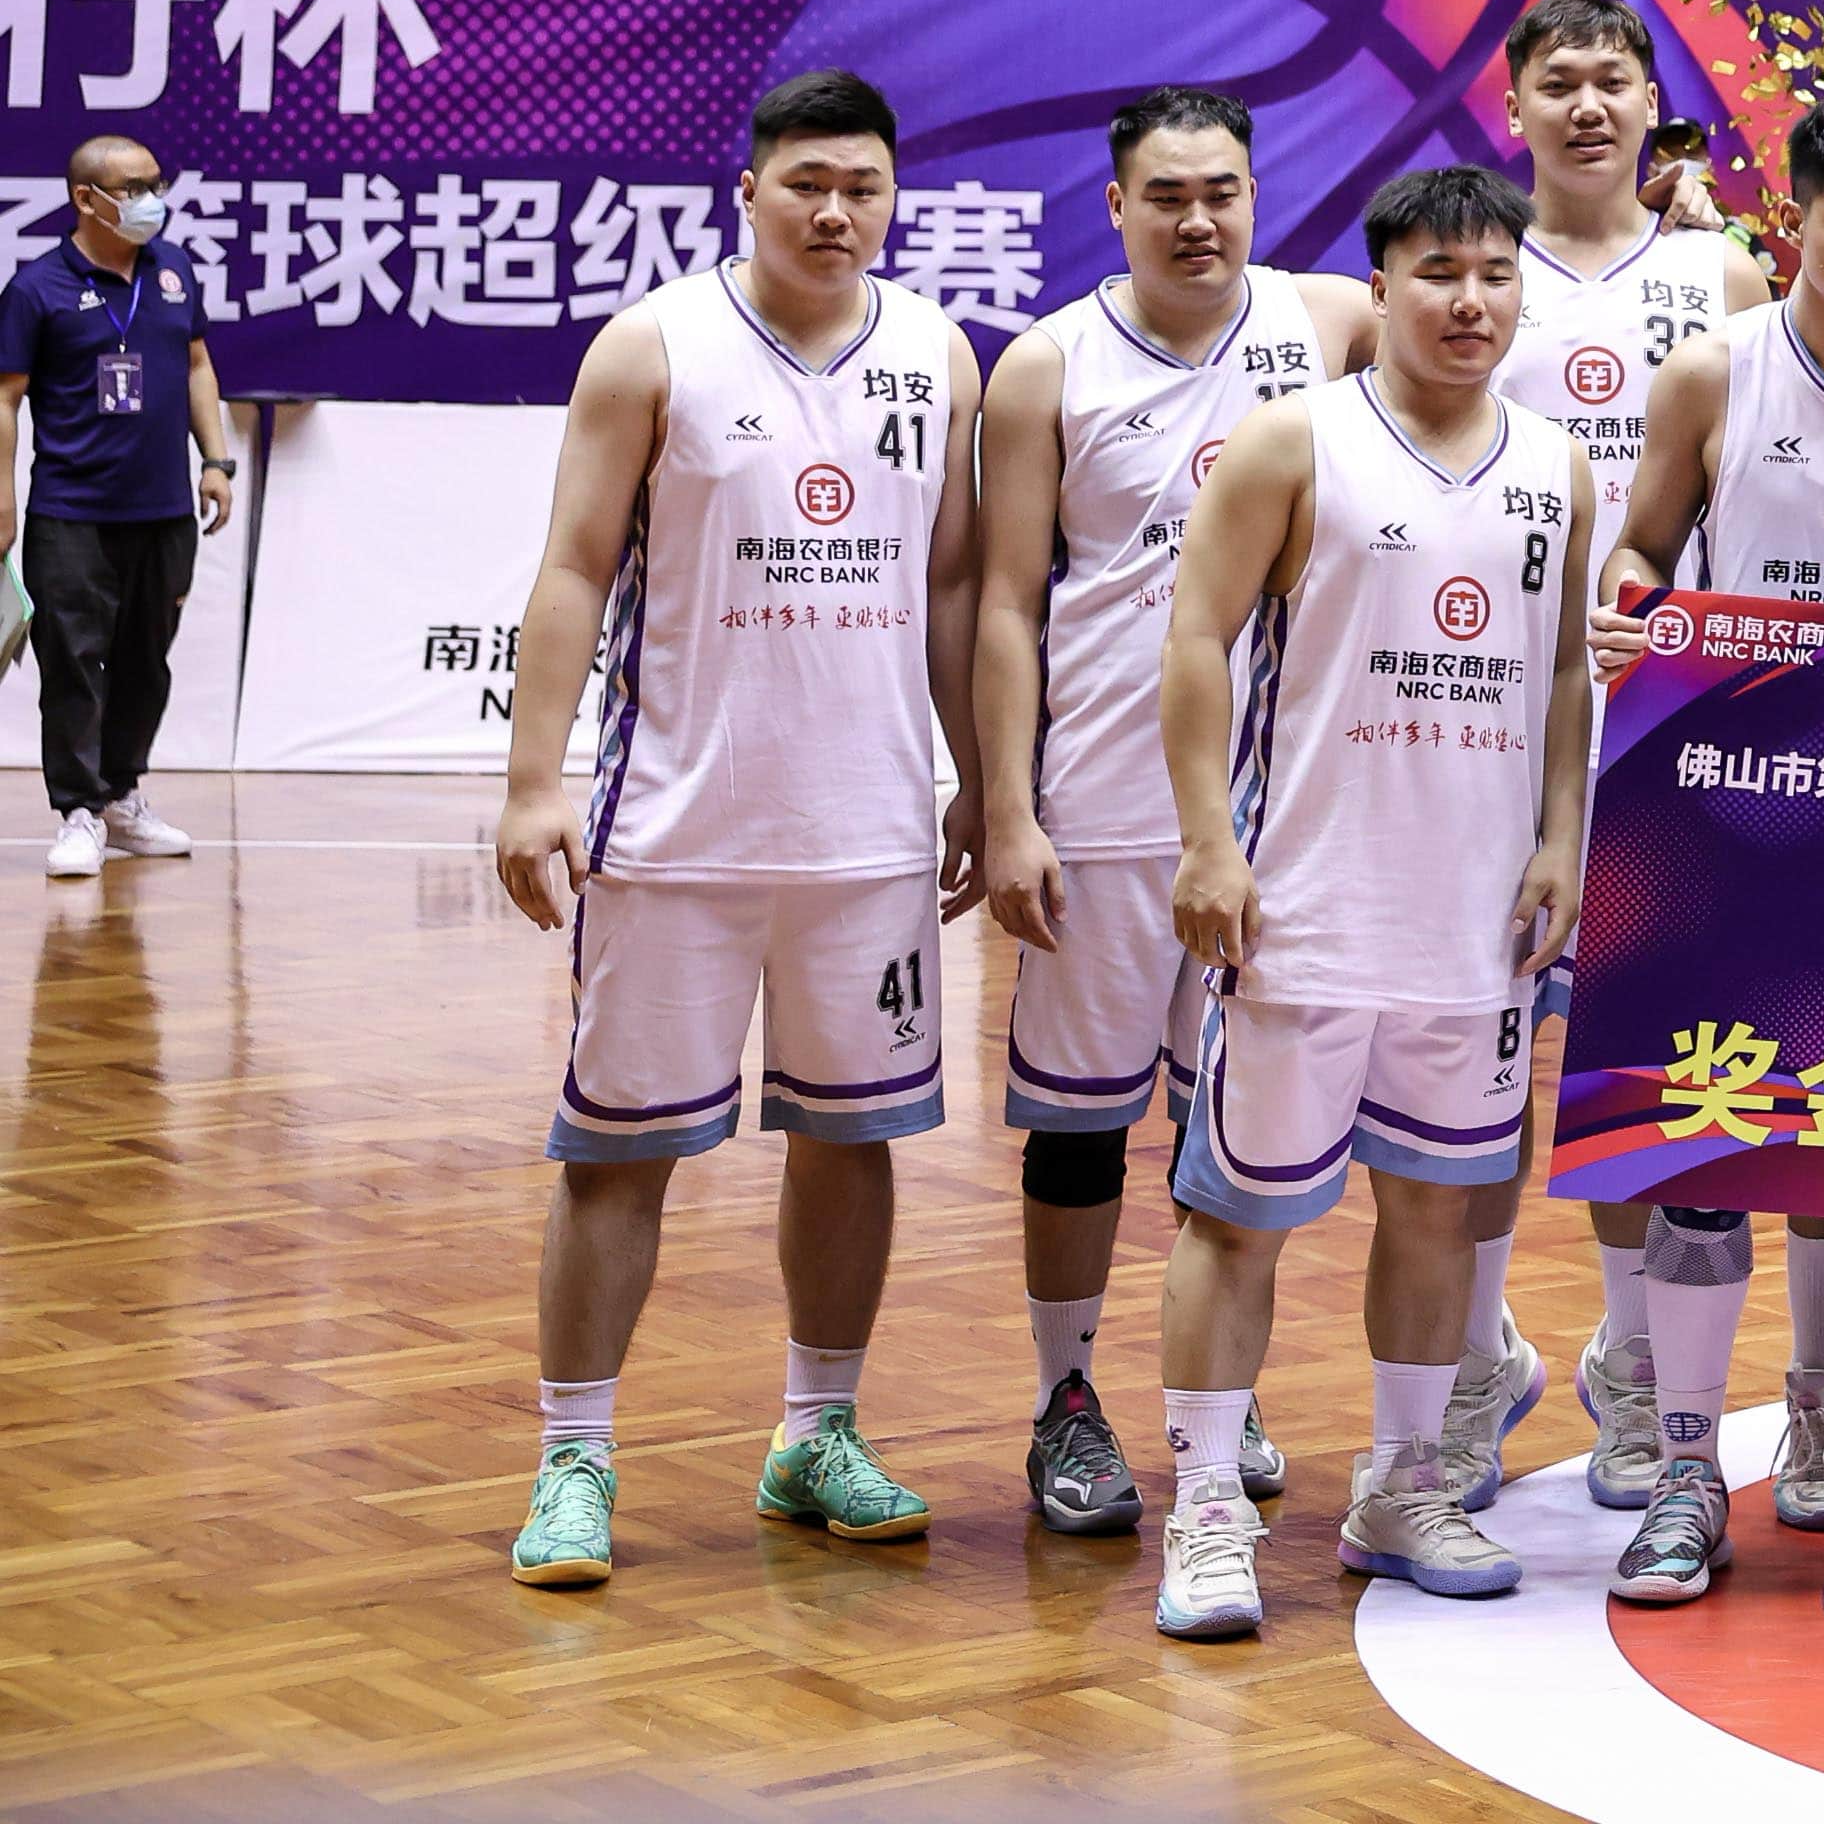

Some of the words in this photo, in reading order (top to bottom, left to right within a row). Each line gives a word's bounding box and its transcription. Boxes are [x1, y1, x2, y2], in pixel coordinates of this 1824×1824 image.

[1641, 279, 1709, 314] 均安
[1242, 342, 1311, 374] 均安
[863, 368, 934, 406] 均安
[725, 433, 775, 442] CYNDICAT
[875, 410, 927, 474] 41
[1118, 428, 1166, 444] CYNDICAT
[1762, 454, 1811, 465] CYNDICAT
[1502, 485, 1564, 527] 均安
[736, 536, 903, 562] 南海农商银行
[1368, 541, 1418, 553] CYNDICAT
[1520, 529, 1548, 595] 8
[765, 566, 816, 584] NRC
[820, 566, 881, 584] BANK
[1368, 649, 1525, 684] 南海农商银行
[1702, 639, 1753, 662] NRC
[1755, 642, 1816, 667] BANK
[1395, 680, 1445, 700] NRC
[1449, 684, 1505, 705] BANK
[876, 948, 925, 1020] 41
[1496, 1006, 1521, 1063] 8
